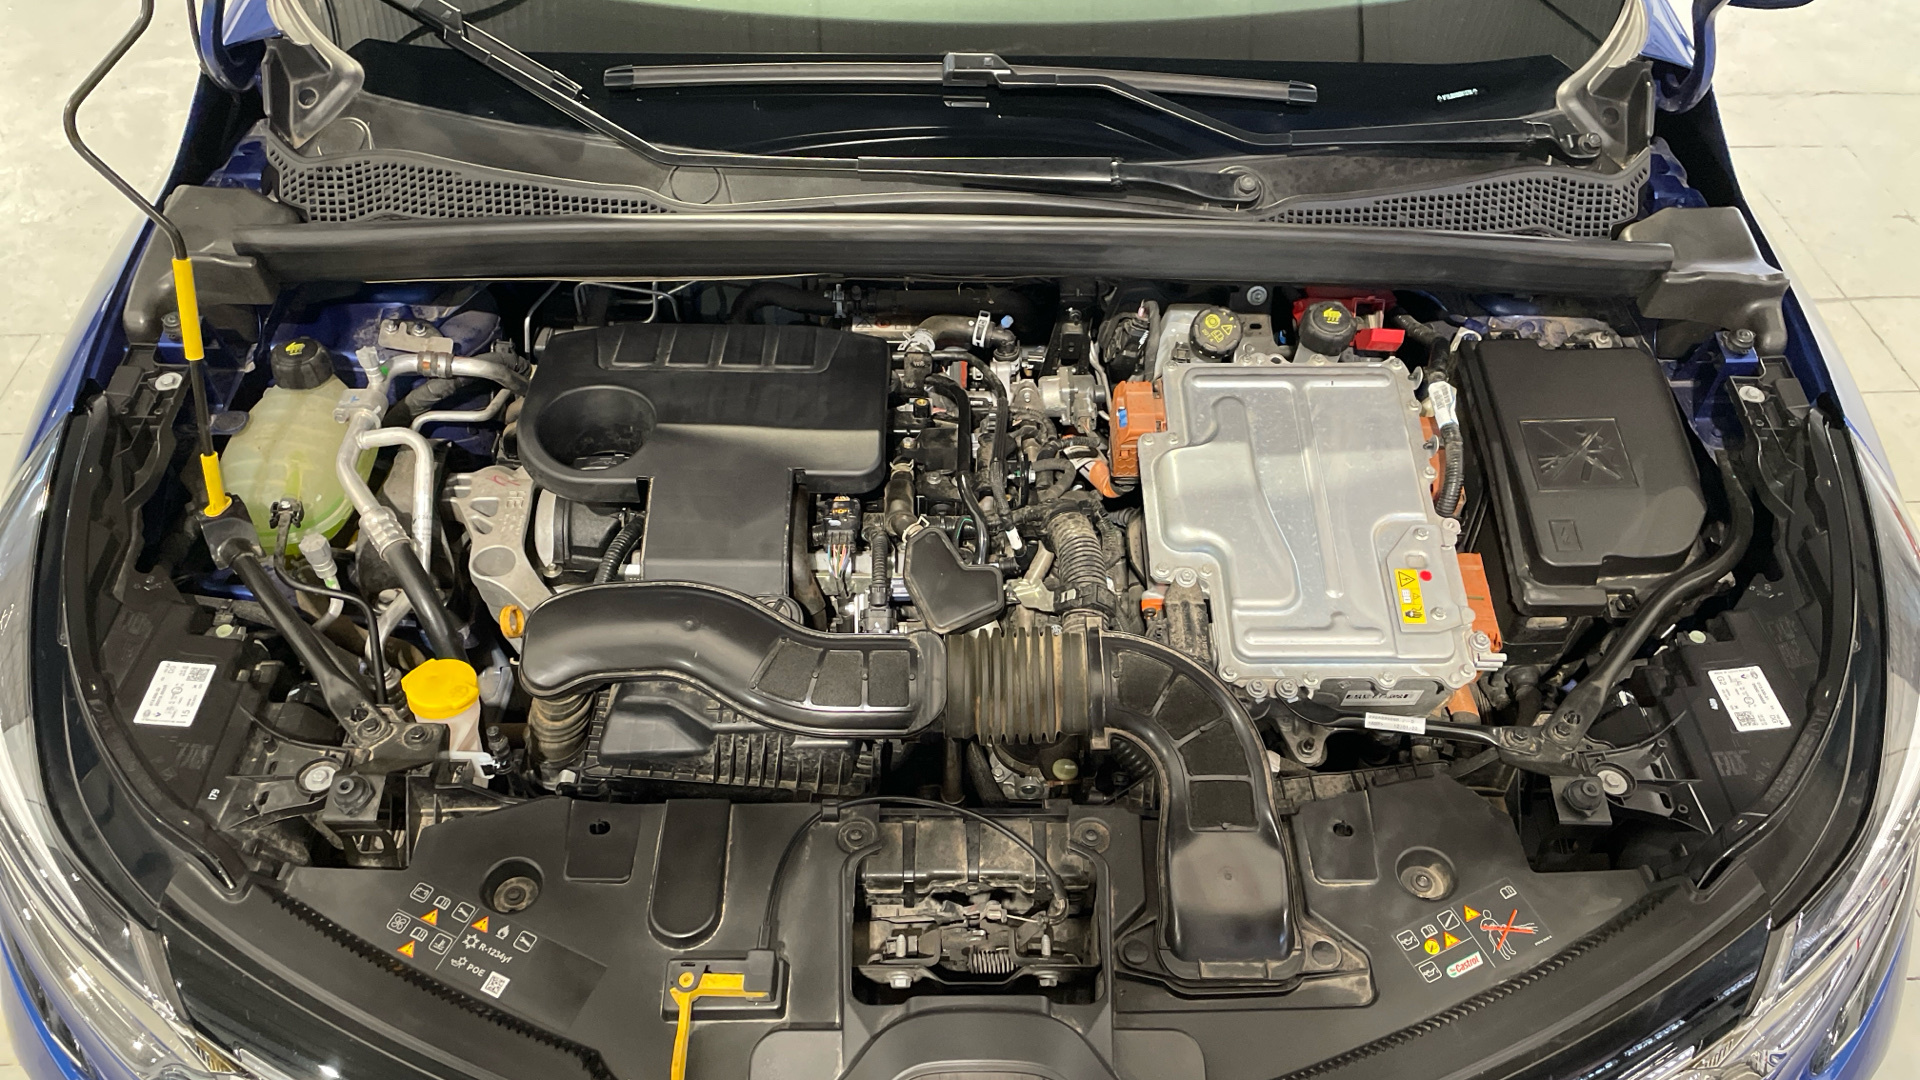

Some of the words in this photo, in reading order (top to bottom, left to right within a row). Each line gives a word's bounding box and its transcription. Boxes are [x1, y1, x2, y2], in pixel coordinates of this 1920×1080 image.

[478, 942, 513, 963] R-1234yf
[466, 963, 486, 977] POE
[1455, 955, 1479, 973] Castrol
